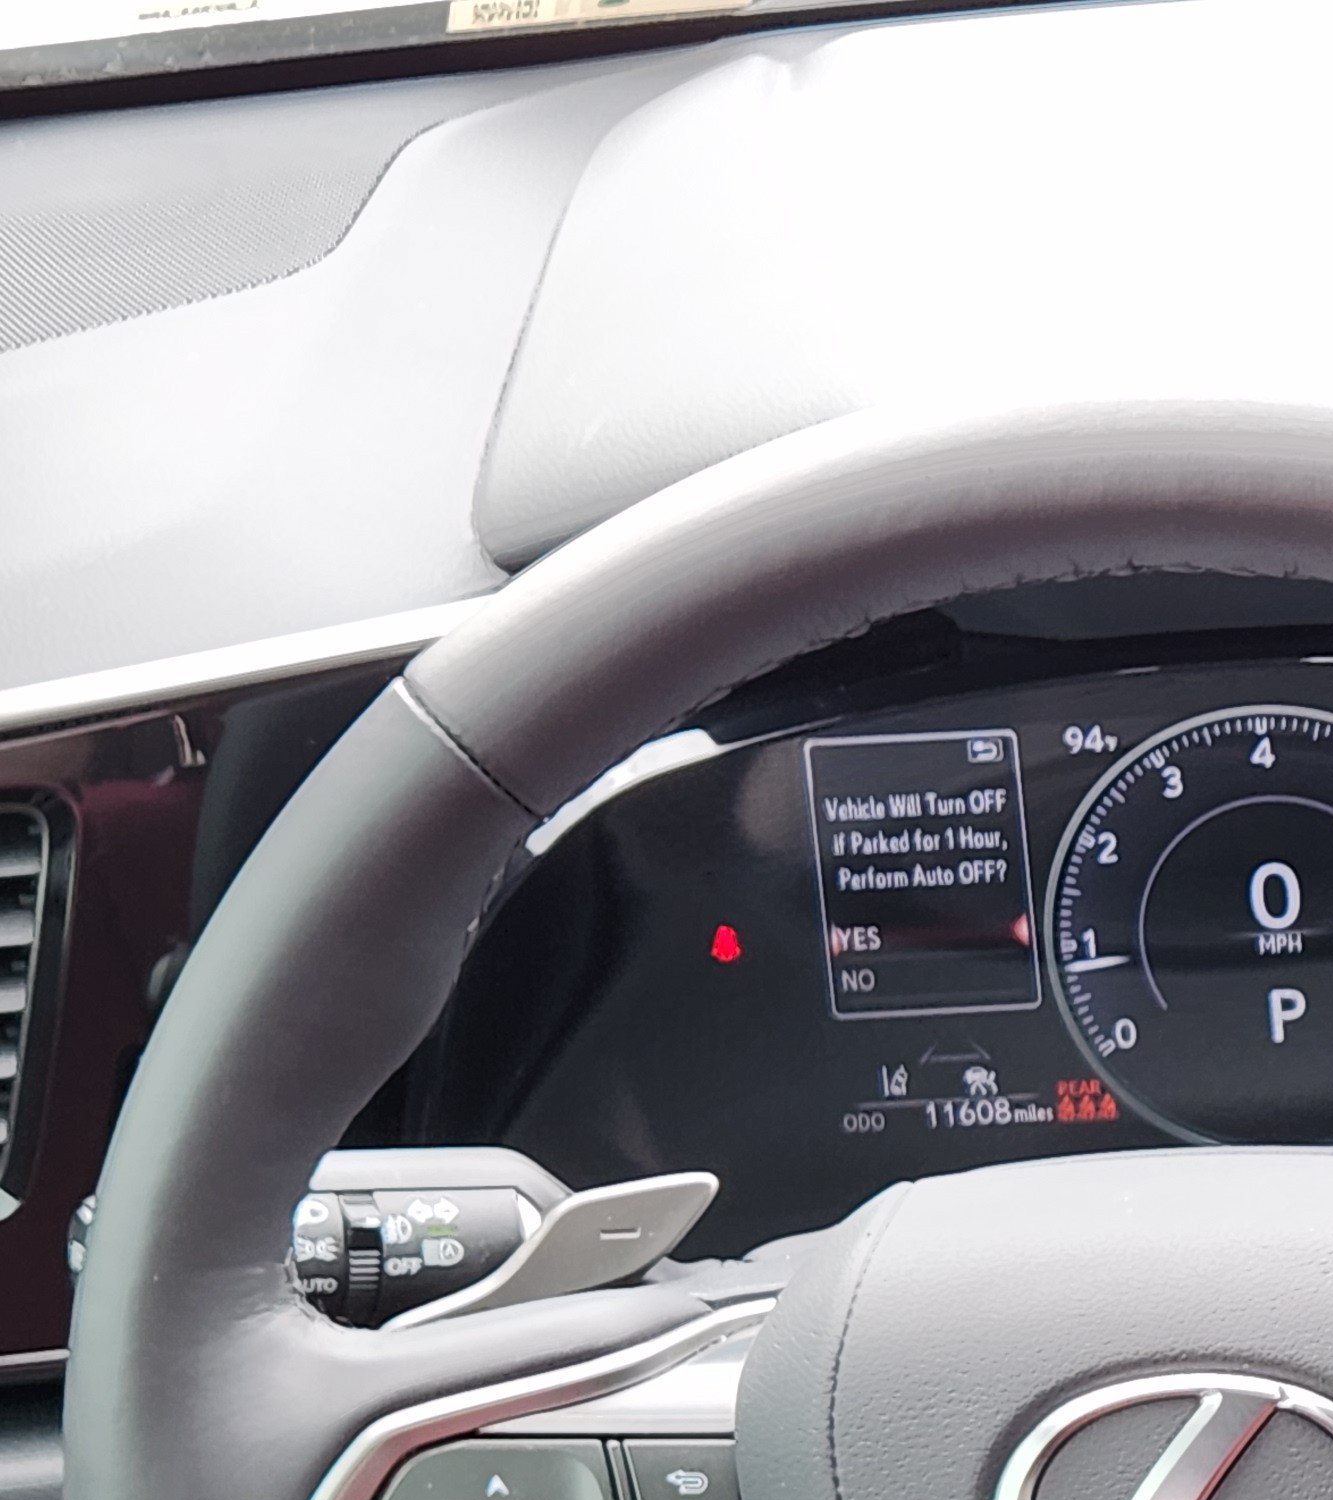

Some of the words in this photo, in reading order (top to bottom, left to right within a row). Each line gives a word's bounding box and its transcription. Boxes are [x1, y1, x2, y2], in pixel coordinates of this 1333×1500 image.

[1250, 738, 1275, 768] 4
[1161, 767, 1184, 799] 3
[824, 795, 886, 822] Vehicle
[888, 792, 923, 818] Will
[924, 791, 966, 817] Turn
[968, 788, 1007, 815] OFF
[850, 829, 911, 855] Parked
[914, 827, 941, 852] for
[944, 826, 955, 850] 1
[958, 825, 1008, 852] Hour,
[1097, 833, 1119, 864] 2
[837, 865, 909, 891] Perform
[912, 862, 955, 887] Auto
[958, 859, 1008, 885] OFF?
[1248, 862, 1301, 930] 0
[839, 925, 881, 951] YES
[1082, 929, 1097, 957] 1
[1258, 935, 1302, 955] MPH
[841, 967, 876, 993] NO
[1267, 988, 1307, 1043] P
[1114, 1018, 1137, 1050] 0
[843, 1112, 885, 1132] ODO
[926, 1097, 1011, 1129] 11608
[1014, 1104, 1054, 1123] miles
[383, 1257, 422, 1276] OFF
[300, 1277, 338, 1294] UTO
